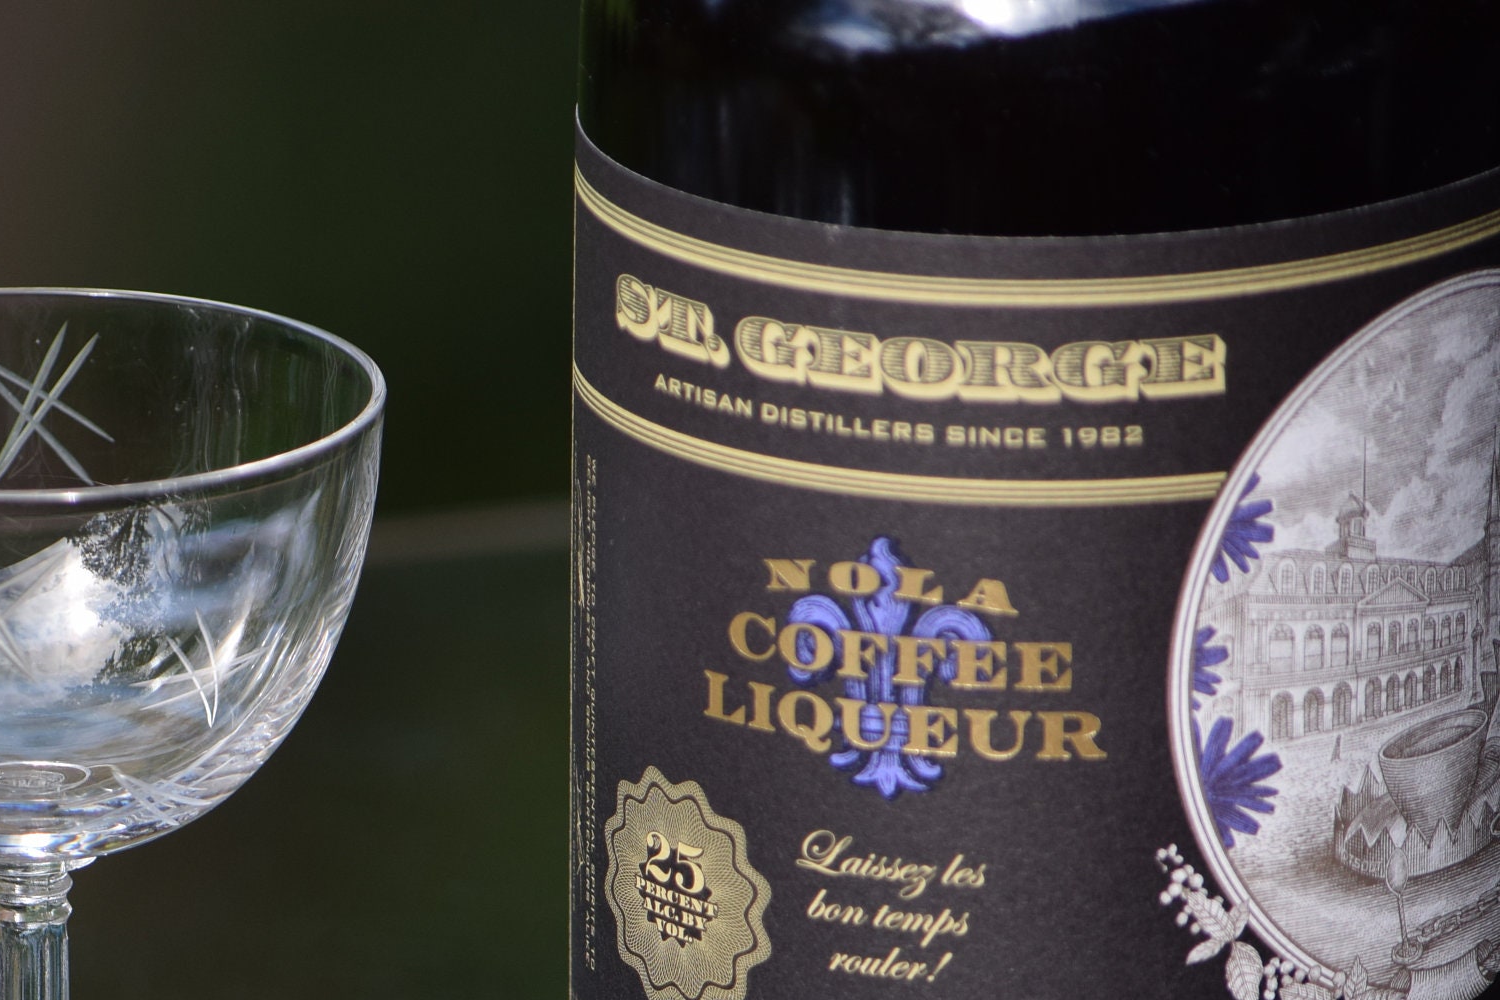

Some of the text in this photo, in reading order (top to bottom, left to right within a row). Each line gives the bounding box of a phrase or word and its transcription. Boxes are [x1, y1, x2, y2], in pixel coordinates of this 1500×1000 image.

[616, 273, 1227, 402] ST. GEORGE
[653, 373, 1144, 448] ARTISAN DISTILLERS SINCE 1982
[762, 558, 1019, 617] NOLA
[728, 611, 1073, 692] COFFEE
[703, 669, 1108, 760] LIQUEUR
[645, 831, 705, 894] 25
[795, 829, 987, 898] Laissez les
[635, 874, 719, 918] PERCENT
[644, 896, 707, 931] ALC. BY
[806, 889, 970, 947] bon temps
[655, 917, 693, 943] VOL.
[828, 947, 954, 982] rouler!
